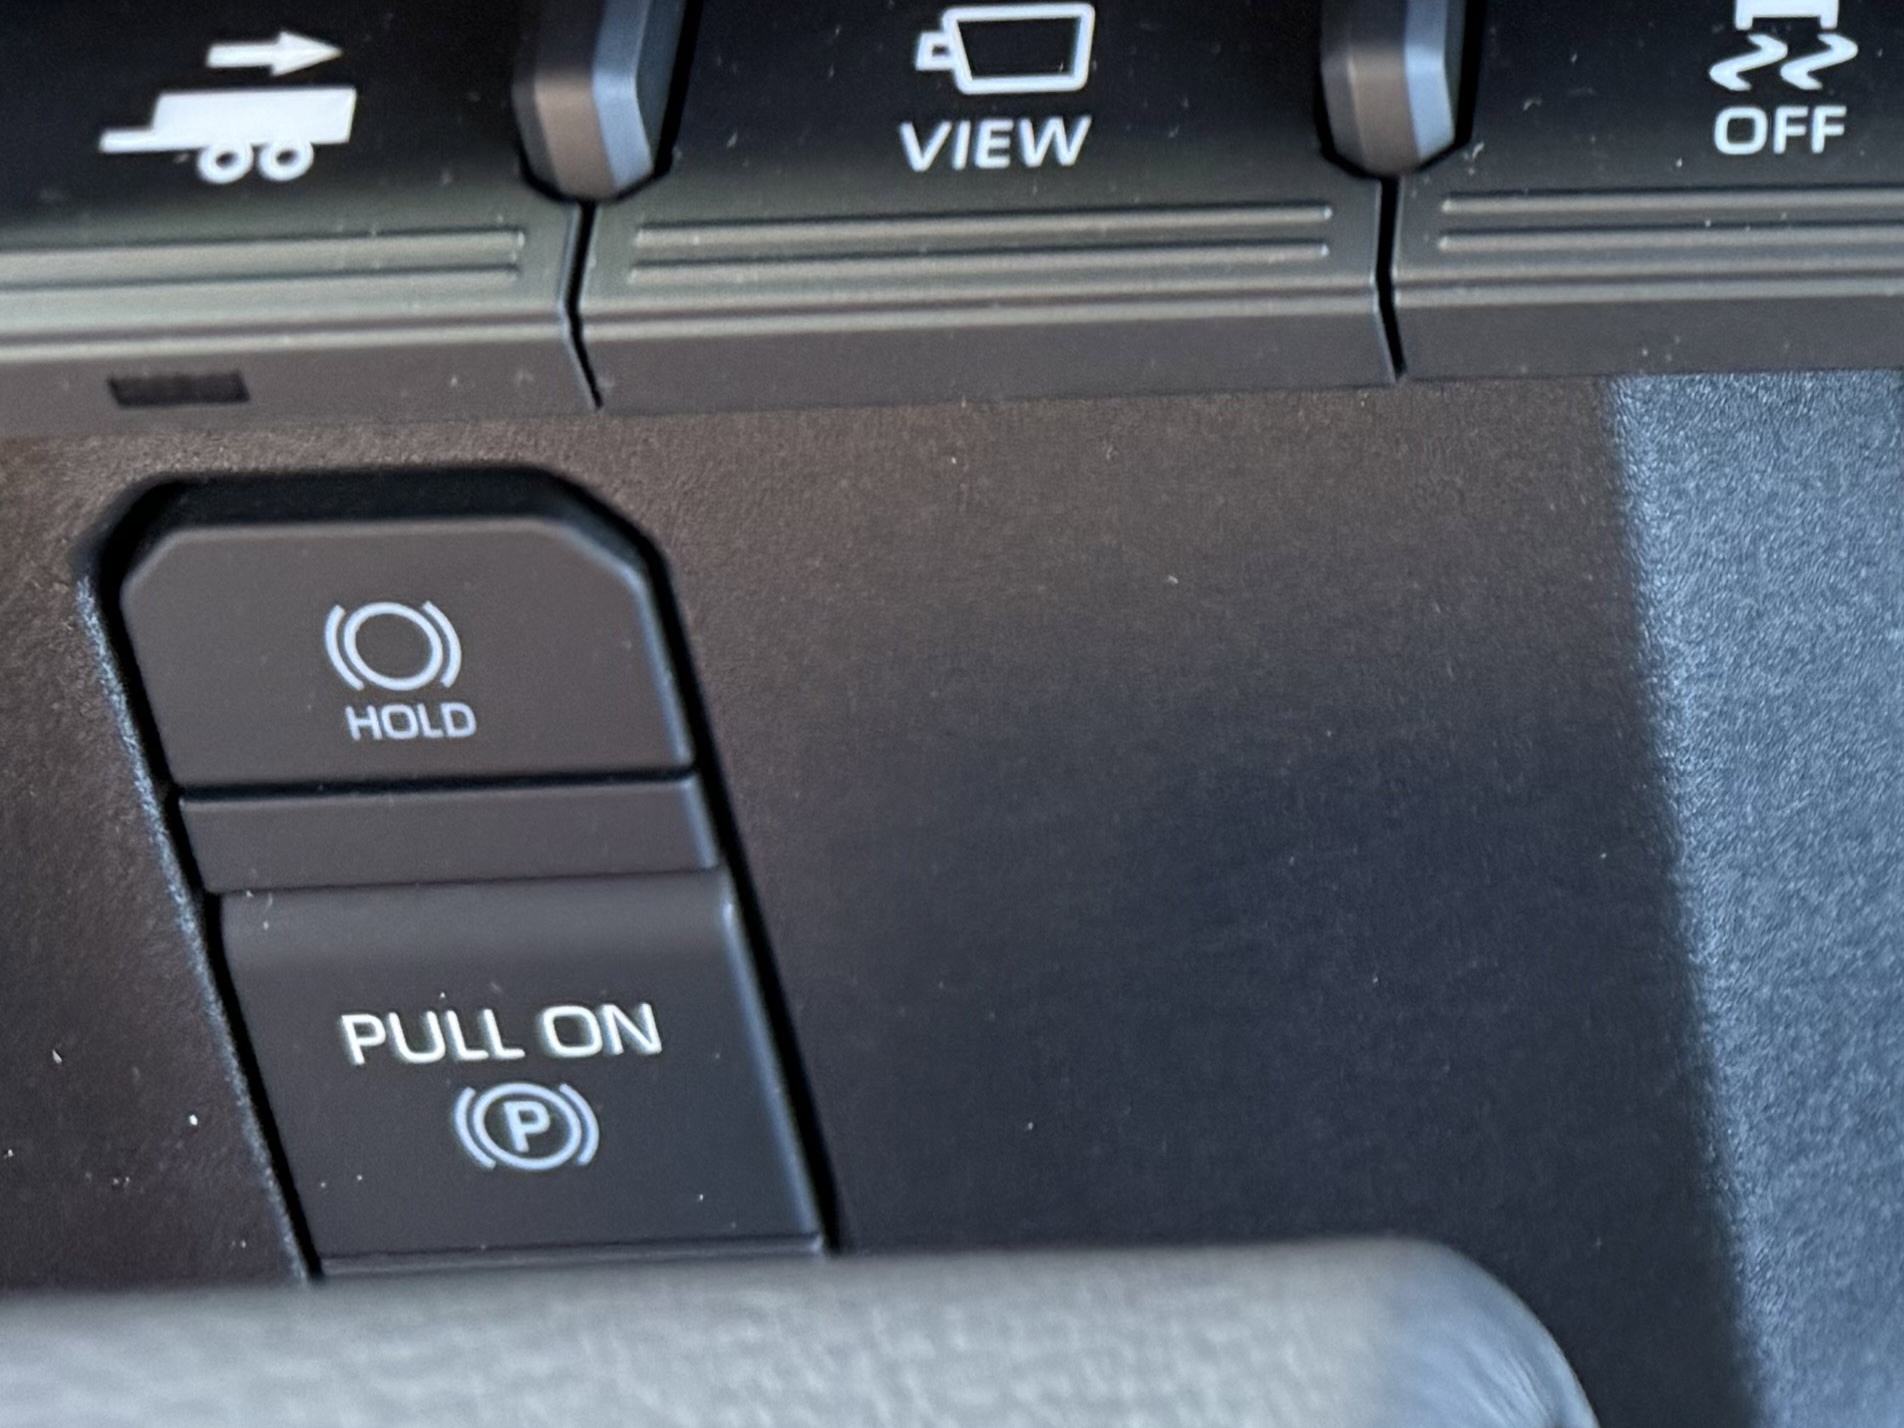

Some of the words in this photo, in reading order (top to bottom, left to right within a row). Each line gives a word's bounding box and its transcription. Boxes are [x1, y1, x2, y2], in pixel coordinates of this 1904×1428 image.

[899, 115, 1092, 172] VIEW
[1713, 105, 1848, 155] OFF
[344, 701, 477, 741] HOLD
[340, 1008, 526, 1065] PULL
[538, 1002, 663, 1058] ON
